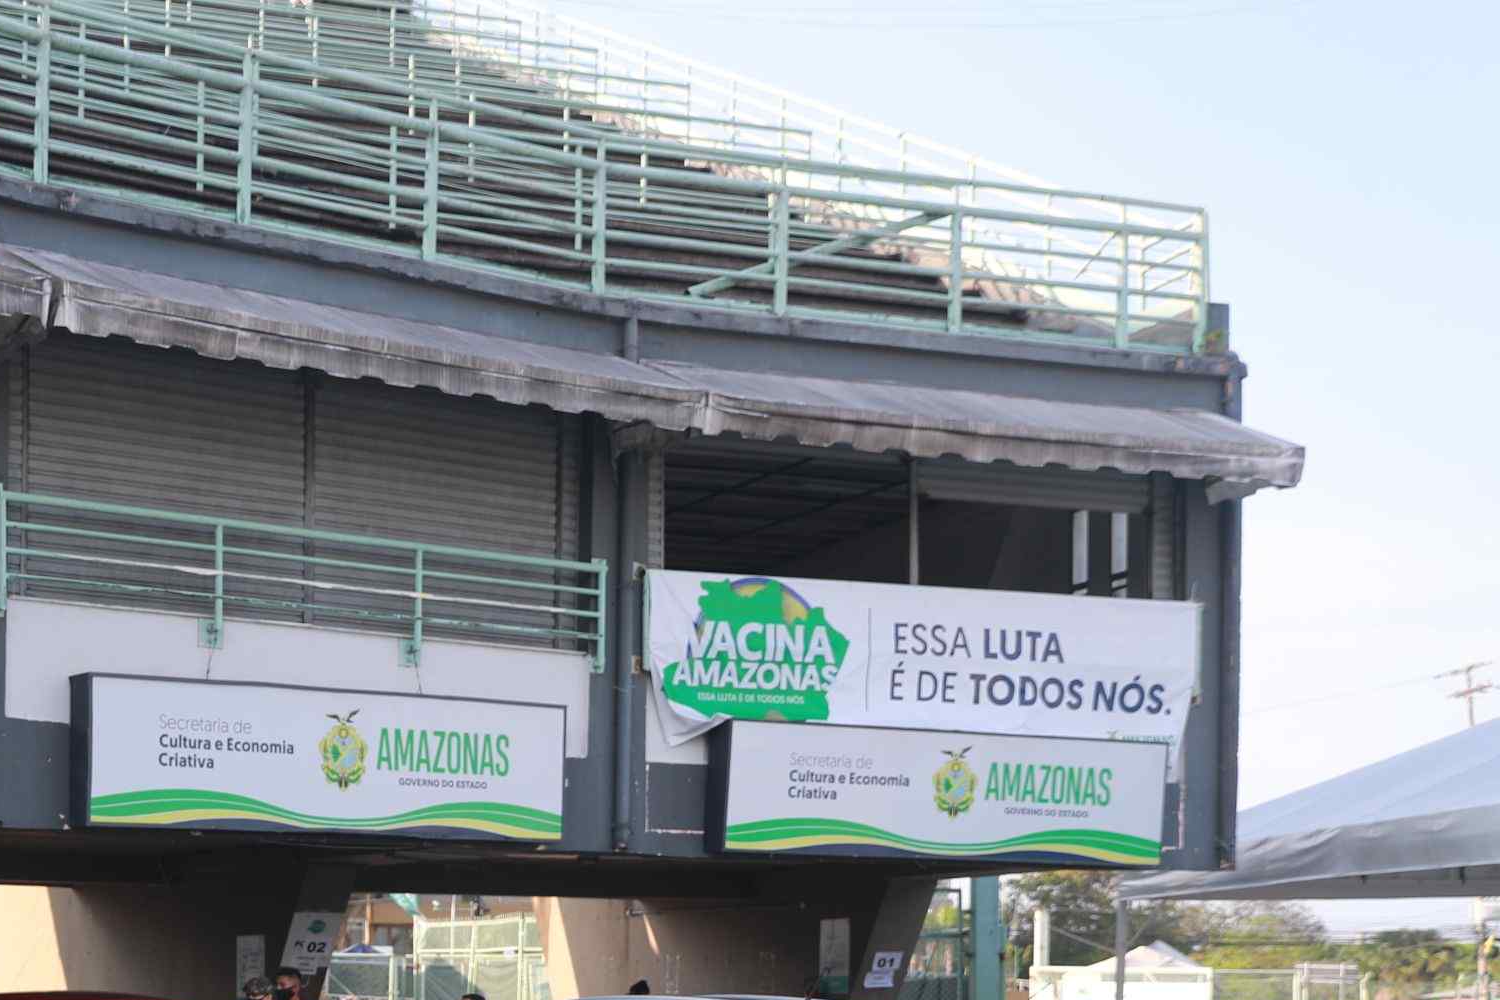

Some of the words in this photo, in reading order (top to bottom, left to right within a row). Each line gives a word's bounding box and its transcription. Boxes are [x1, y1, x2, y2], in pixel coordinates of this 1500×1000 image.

[685, 620, 837, 664] VACINA
[893, 622, 972, 659] ESSA
[982, 628, 1065, 664] LUTA
[671, 659, 839, 692] AMAZONAS
[889, 660, 905, 701] É
[916, 670, 959, 703] DE
[969, 673, 1085, 710] TODOS
[1092, 674, 1172, 716] NÓS.
[158, 713, 230, 734] Secretaria
[232, 720, 253, 735] de
[159, 733, 211, 751] Cultura
[214, 740, 223, 751] e
[226, 737, 295, 755] Economia
[376, 726, 510, 777] AMAZONAS
[158, 752, 215, 769] Criativa
[789, 751, 853, 769] Secretaria
[855, 756, 873, 770] de
[398, 777, 440, 788] GOVERNO
[441, 779, 454, 788] DO
[456, 779, 488, 790] ESTADO
[789, 769, 836, 784] Cultura
[838, 774, 846, 784] e
[849, 772, 910, 788] Economia
[984, 761, 1113, 807] AMAZONAS
[787, 785, 838, 801] Criativa
[306, 941, 327, 953] 02
[877, 956, 895, 968] 01
